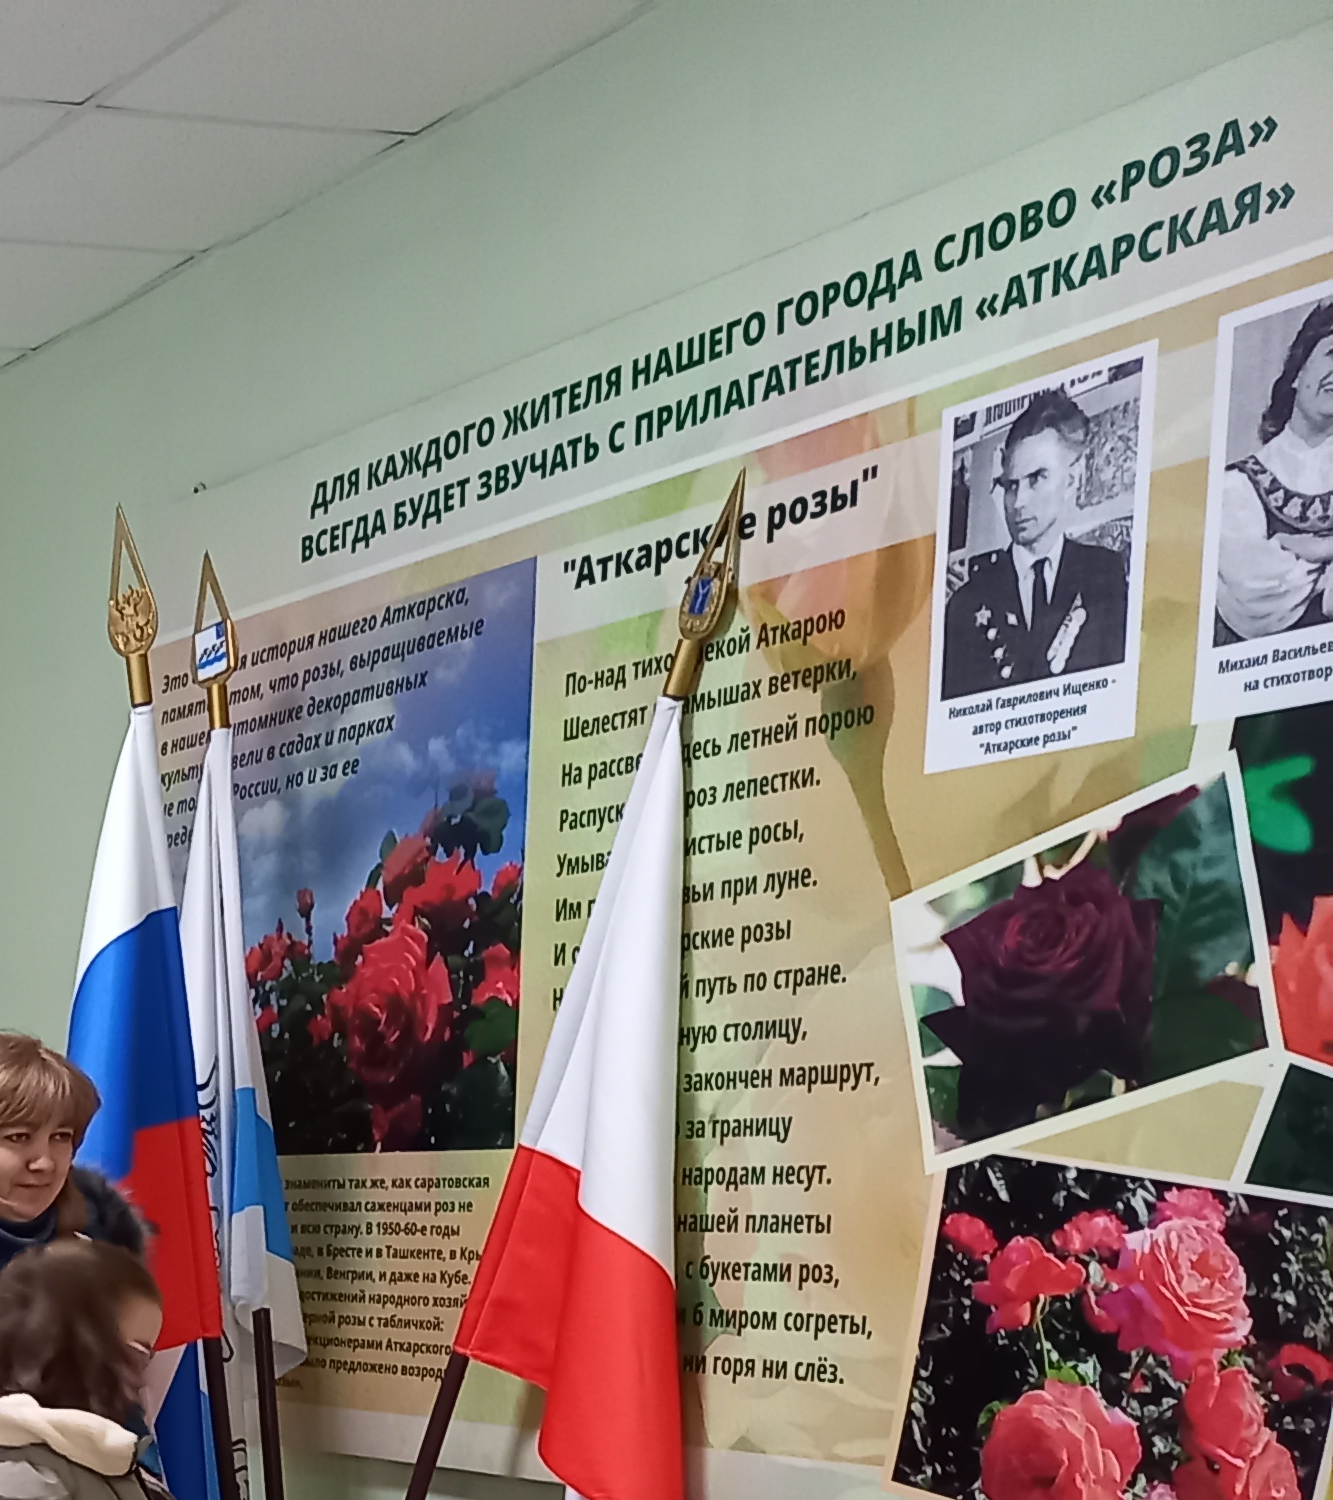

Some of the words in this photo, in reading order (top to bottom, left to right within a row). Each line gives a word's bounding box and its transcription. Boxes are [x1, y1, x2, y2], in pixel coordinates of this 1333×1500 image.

[309, 466, 360, 520] ДЛЯ
[366, 416, 495, 491] КАЖДОГО
[501, 364, 623, 441] ЖИТЕЛЯ
[631, 311, 767, 392] НАШЕГО
[776, 248, 924, 336] ГОРОДА
[933, 187, 1077, 273] СЛОВО
[1090, 115, 1279, 210] «РОЗА»
[300, 508, 387, 563] ВСЕГДА
[393, 476, 471, 531] БУДЕТ
[476, 432, 600, 502] ЗВУЧАТЬ
[607, 420, 626, 454] С
[634, 295, 964, 447] ПРИЛАГАТЕЛЬНЫМ
[975, 181, 1296, 322] «АТКАРСКАЯ»
[563, 511, 757, 591] "Аткарске
[766, 464, 879, 544] розы"
[251, 632, 316, 668] история
[317, 614, 377, 648] нашего
[379, 586, 470, 629] Аткарска,
[301, 658, 346, 692] розы,
[348, 617, 485, 673] выращиваемые
[564, 663, 627, 698] По-над
[755, 608, 846, 651] Аткарою
[306, 670, 429, 717] декоративных
[562, 705, 648, 743] Шелестят
[767, 657, 858, 697] ветерки,
[947, 698, 994, 720] Николай
[995, 689, 1060, 711] Гаврилович
[1062, 677, 1109, 697] Ищенко
[726, 712, 799, 755] летней
[804, 704, 875, 741] порою
[971, 720, 1002, 736] автор
[1004, 703, 1088, 731] стихотворения
[979, 734, 1041, 756] "Аткарские
[1041, 725, 1078, 748] розы"
[721, 765, 822, 804] лепестки.
[747, 818, 805, 855] росы,
[720, 875, 758, 906] при
[762, 866, 818, 900] луне.
[740, 918, 792, 954] розы
[694, 974, 738, 1005] путь
[742, 971, 768, 994] по
[773, 962, 847, 997] стране.
[723, 1016, 808, 1046] столицу,
[682, 1068, 773, 1093] закончен
[778, 1061, 881, 1095] маршрут,
[685, 1118, 706, 1140] за
[711, 1115, 794, 1147] границу
[413, 1176, 490, 1194] саратовская
[681, 1164, 766, 1194] народам
[771, 1164, 833, 1193] несут.
[676, 1206, 739, 1234] нашей
[744, 1213, 832, 1235] планеты
[384, 1244, 446, 1263] Ташкенте,
[439, 1269, 472, 1289] Кубе.
[699, 1254, 792, 1288] букетами
[797, 1262, 841, 1292] роз,
[708, 1307, 778, 1337] миром
[783, 1310, 873, 1341] согреты,
[712, 1355, 756, 1385] горя
[761, 1357, 788, 1380] ни
[793, 1356, 846, 1385] слёз.
